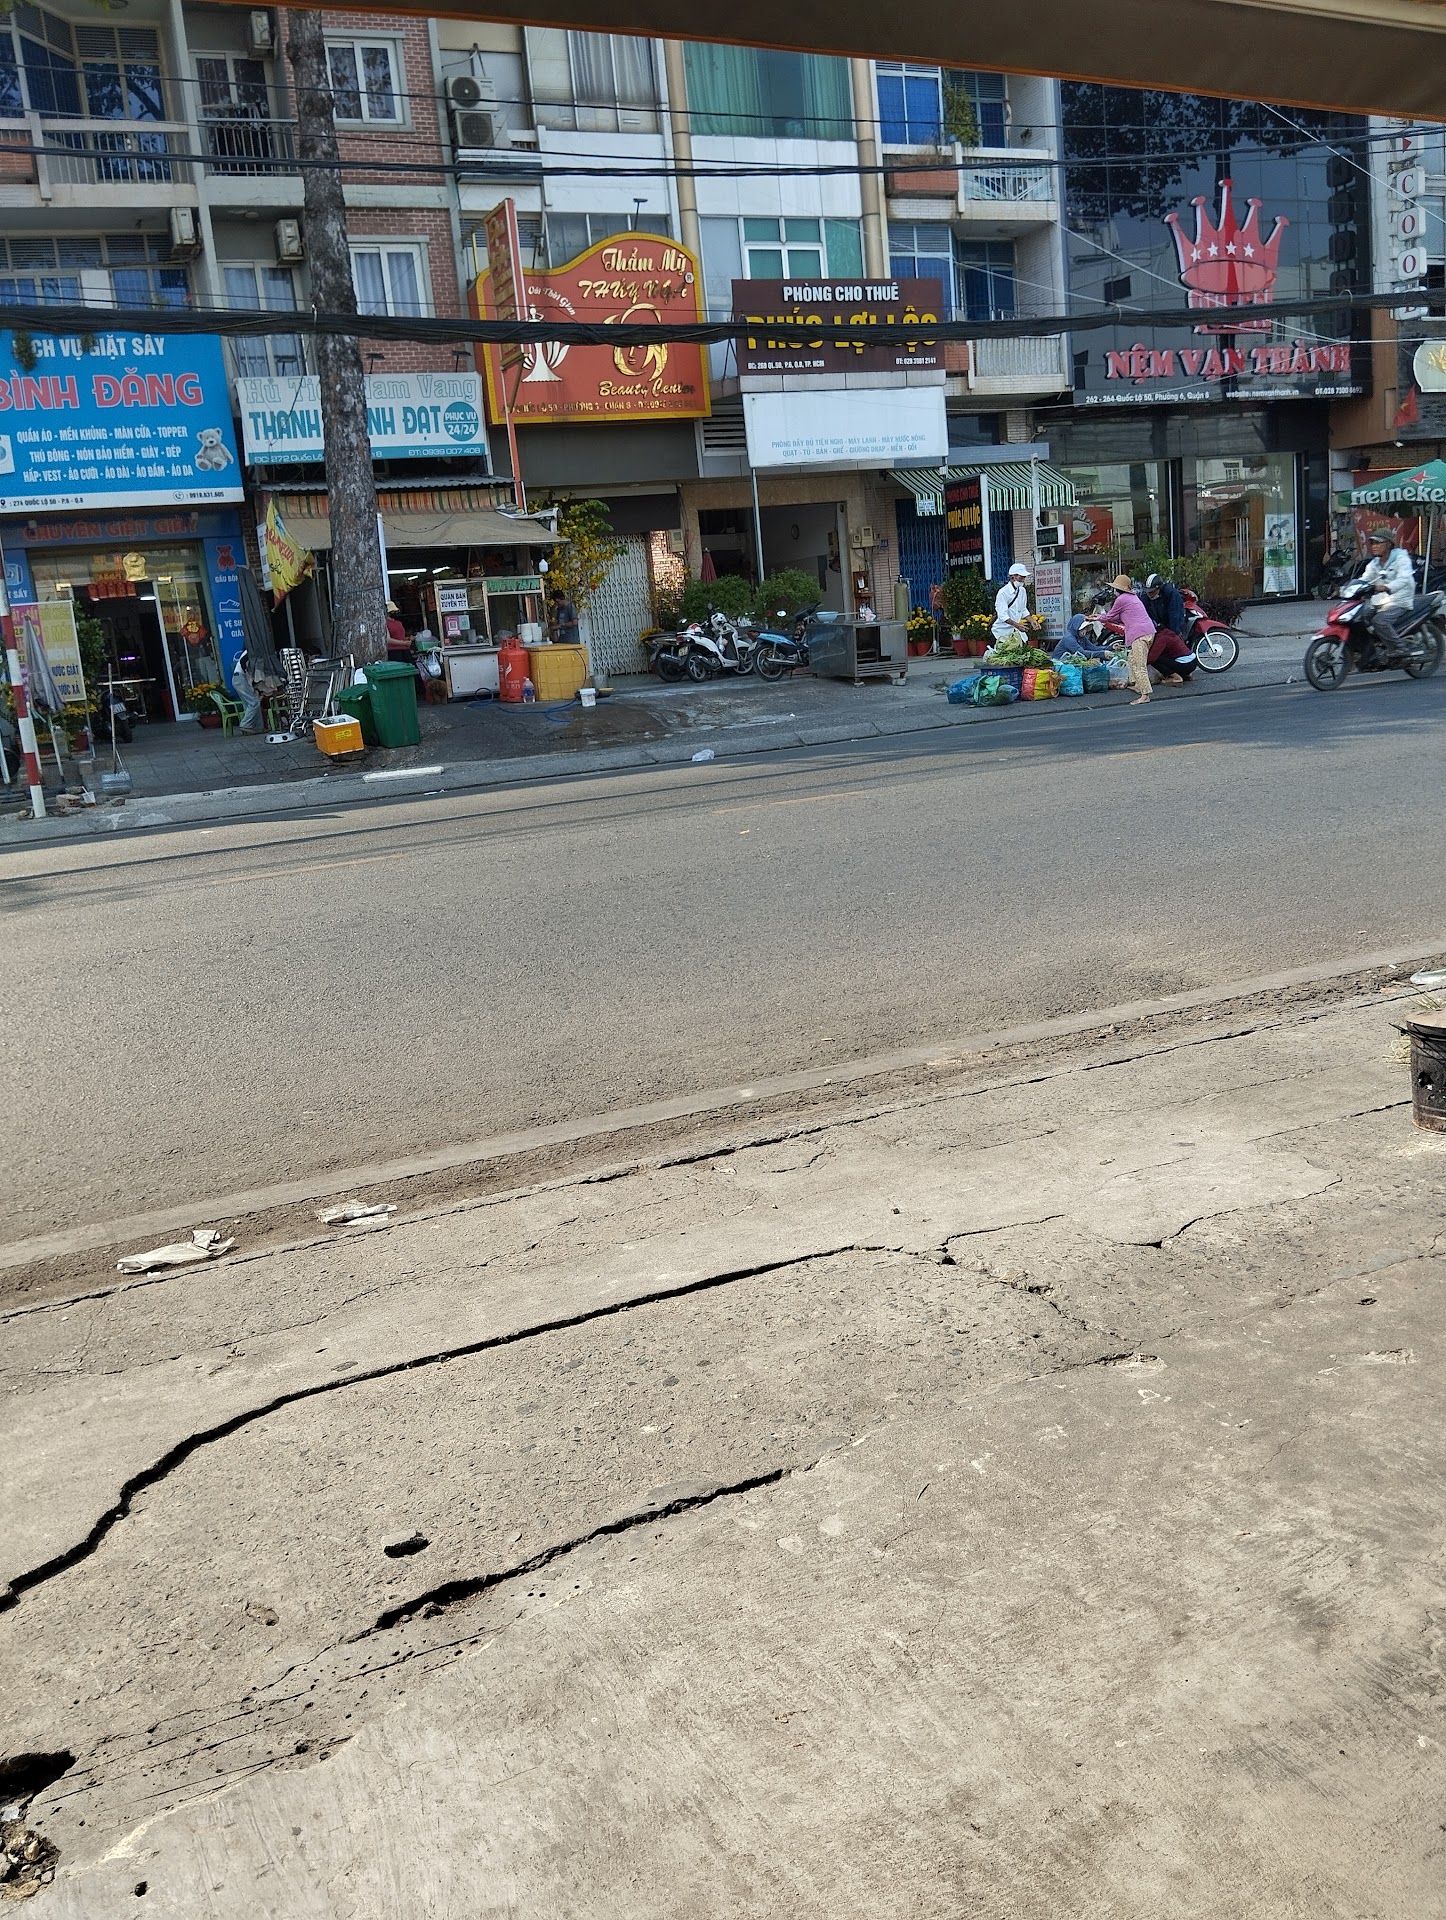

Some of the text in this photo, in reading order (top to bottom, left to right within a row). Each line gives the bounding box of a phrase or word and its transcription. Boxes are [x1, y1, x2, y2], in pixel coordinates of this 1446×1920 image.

[601, 247, 687, 276] Thẩm Mỹ
[782, 282, 899, 302] PHÒNG CHO THUÊ
[59, 338, 84, 361] VỤ
[1106, 339, 1350, 385] NỆM VẠN THÀNH
[244, 374, 477, 403] Hủ am Vang
[1085, 396, 1099, 404] 262
[1103, 395, 1115, 403] 264
[157, 426, 188, 439] TOPPER
[248, 409, 322, 441] THANH
[403, 406, 441, 442] ĐẠT
[448, 424, 476, 435] 24/24
[271, 455, 290, 463] 272
[42, 470, 61, 482] VEST
[1350, 486, 1446, 505] Heineke
